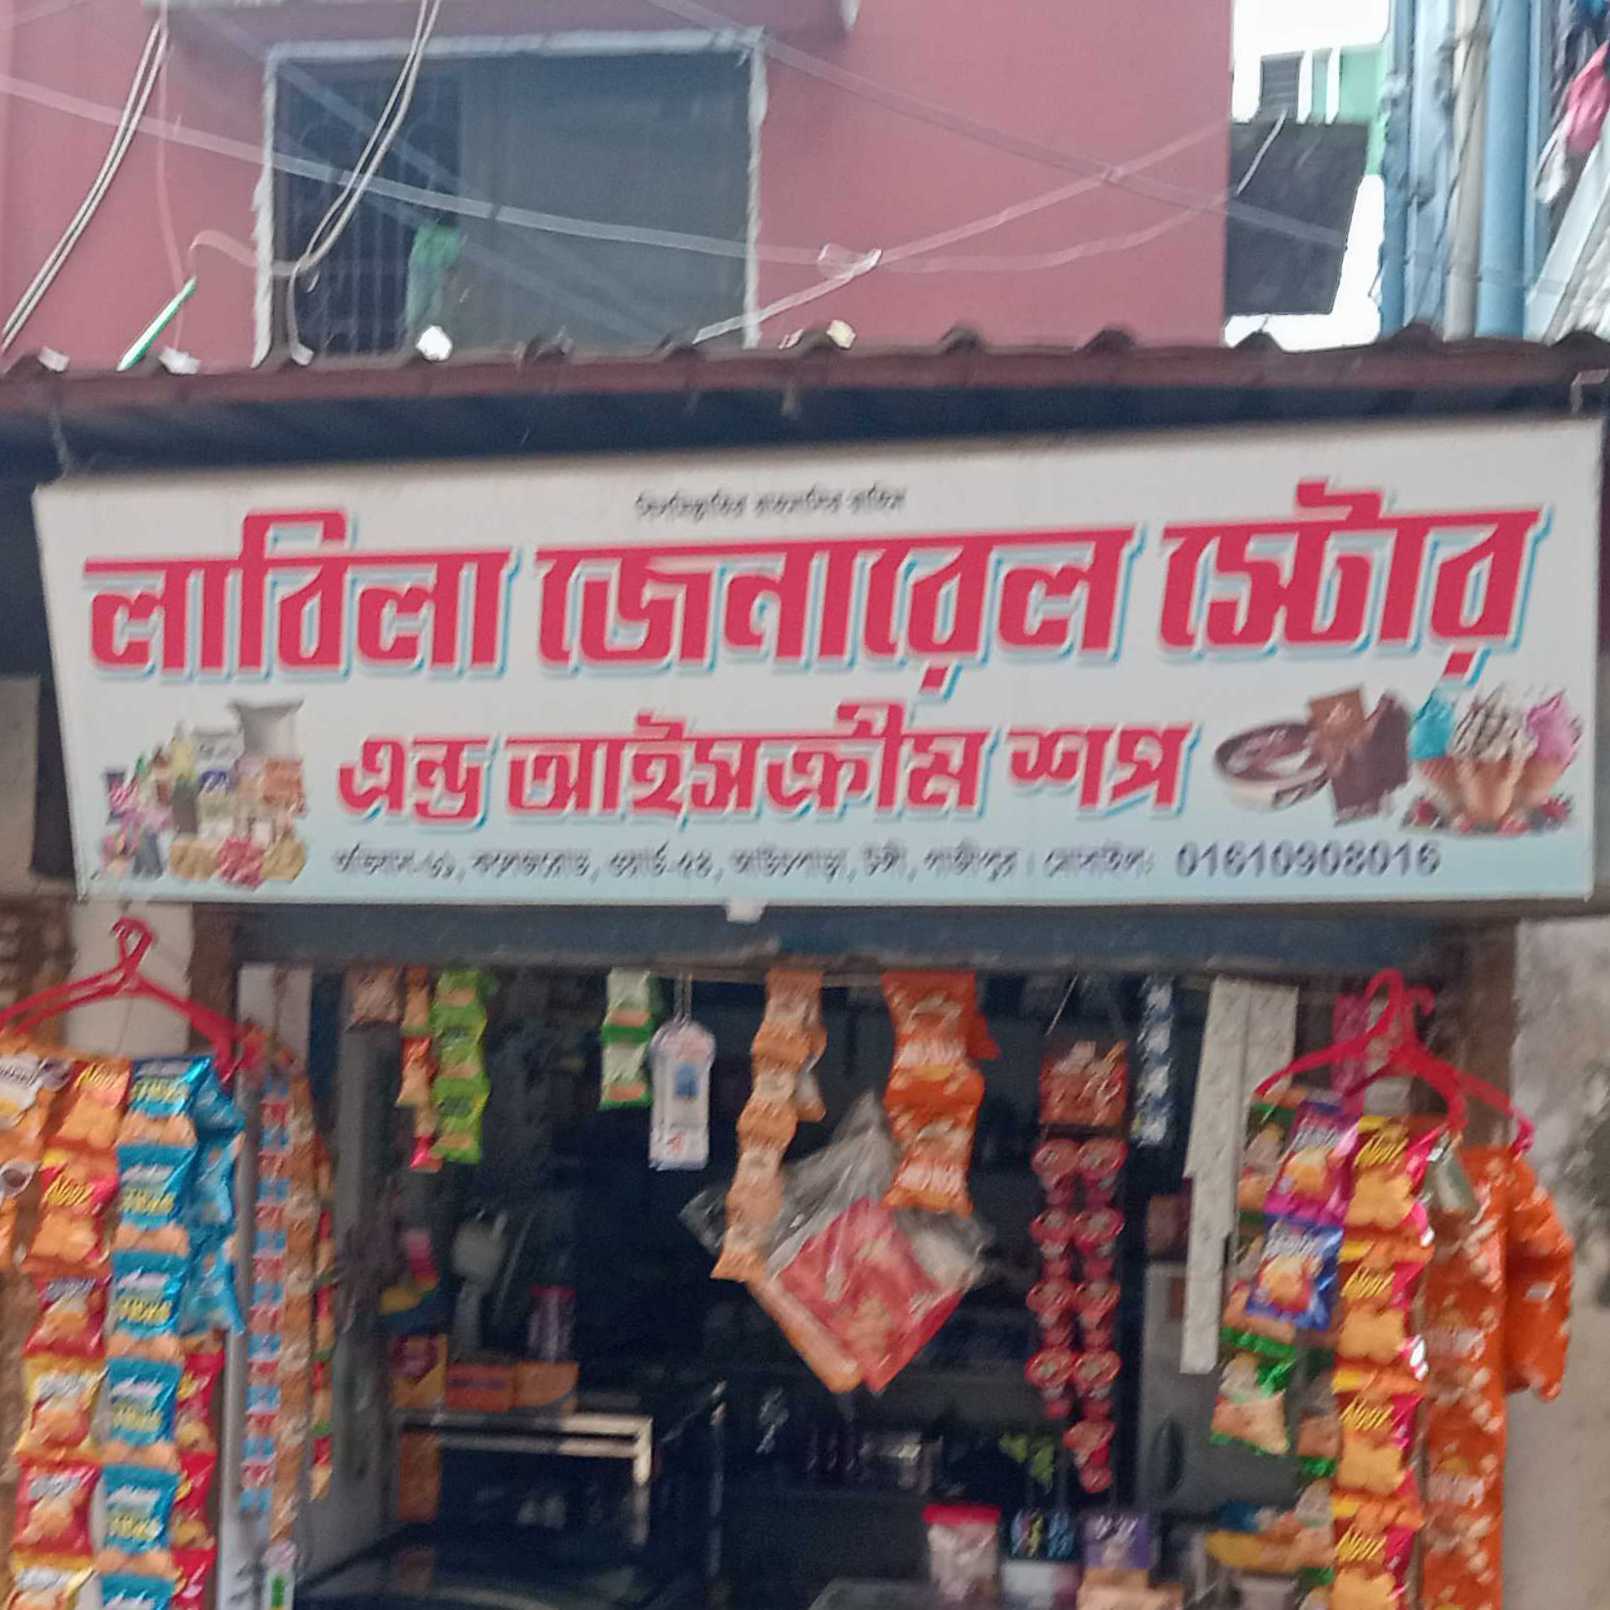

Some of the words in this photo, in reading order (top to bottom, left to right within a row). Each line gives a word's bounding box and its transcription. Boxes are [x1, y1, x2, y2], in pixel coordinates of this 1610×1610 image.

[86, 510, 515, 674] লাবিলা
[536, 527, 1140, 690] জেনারেল
[339, 738, 488, 820] এন্ড
[506, 703, 990, 814] আইসক্রীম
[1008, 726, 1192, 807] শপ
[1176, 840, 1441, 879] 01610908016
